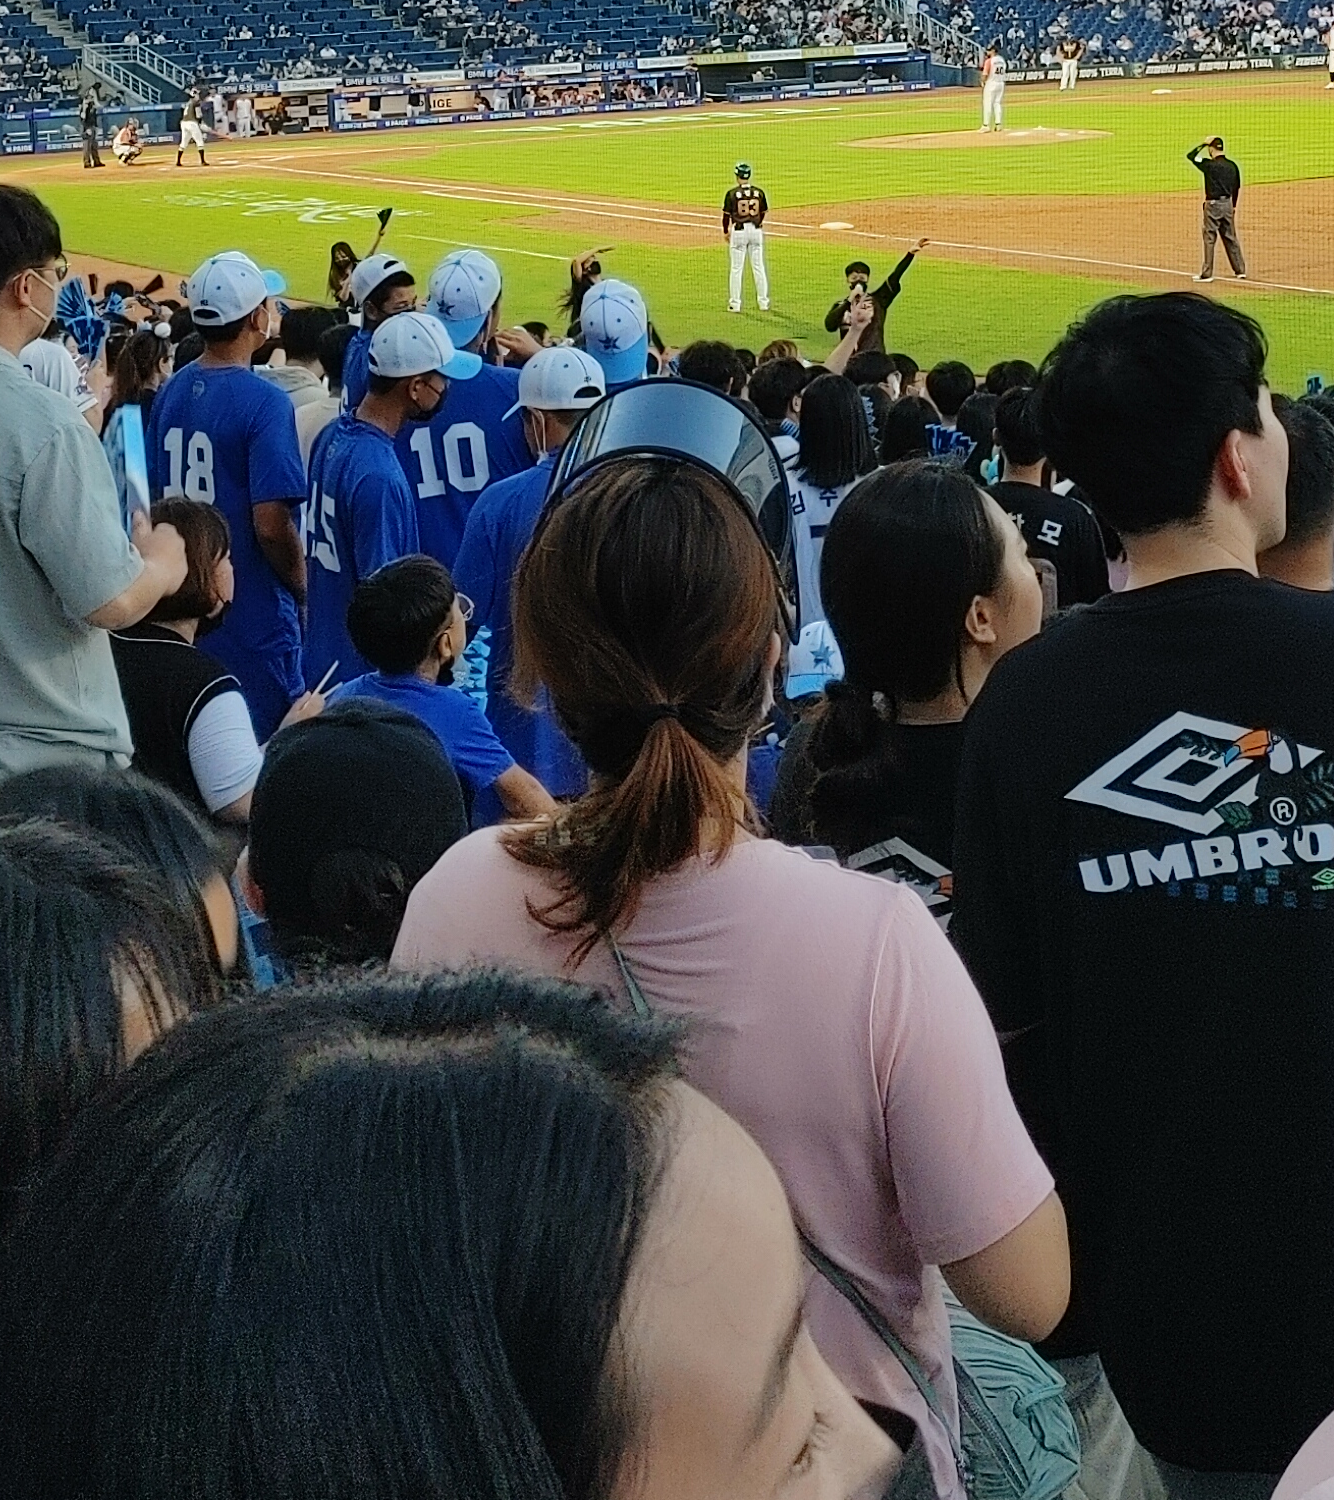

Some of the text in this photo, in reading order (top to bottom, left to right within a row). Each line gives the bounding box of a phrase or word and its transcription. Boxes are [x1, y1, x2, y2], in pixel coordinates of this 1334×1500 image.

[1249, 58, 1273, 68] TERRA
[468, 70, 486, 79] BMW
[1099, 66, 1124, 77] TERRA
[345, 78, 365, 86] BMW
[432, 99, 452, 108] IGE
[737, 199, 760, 217] 83
[409, 421, 490, 499] 10
[163, 427, 216, 506] 18
